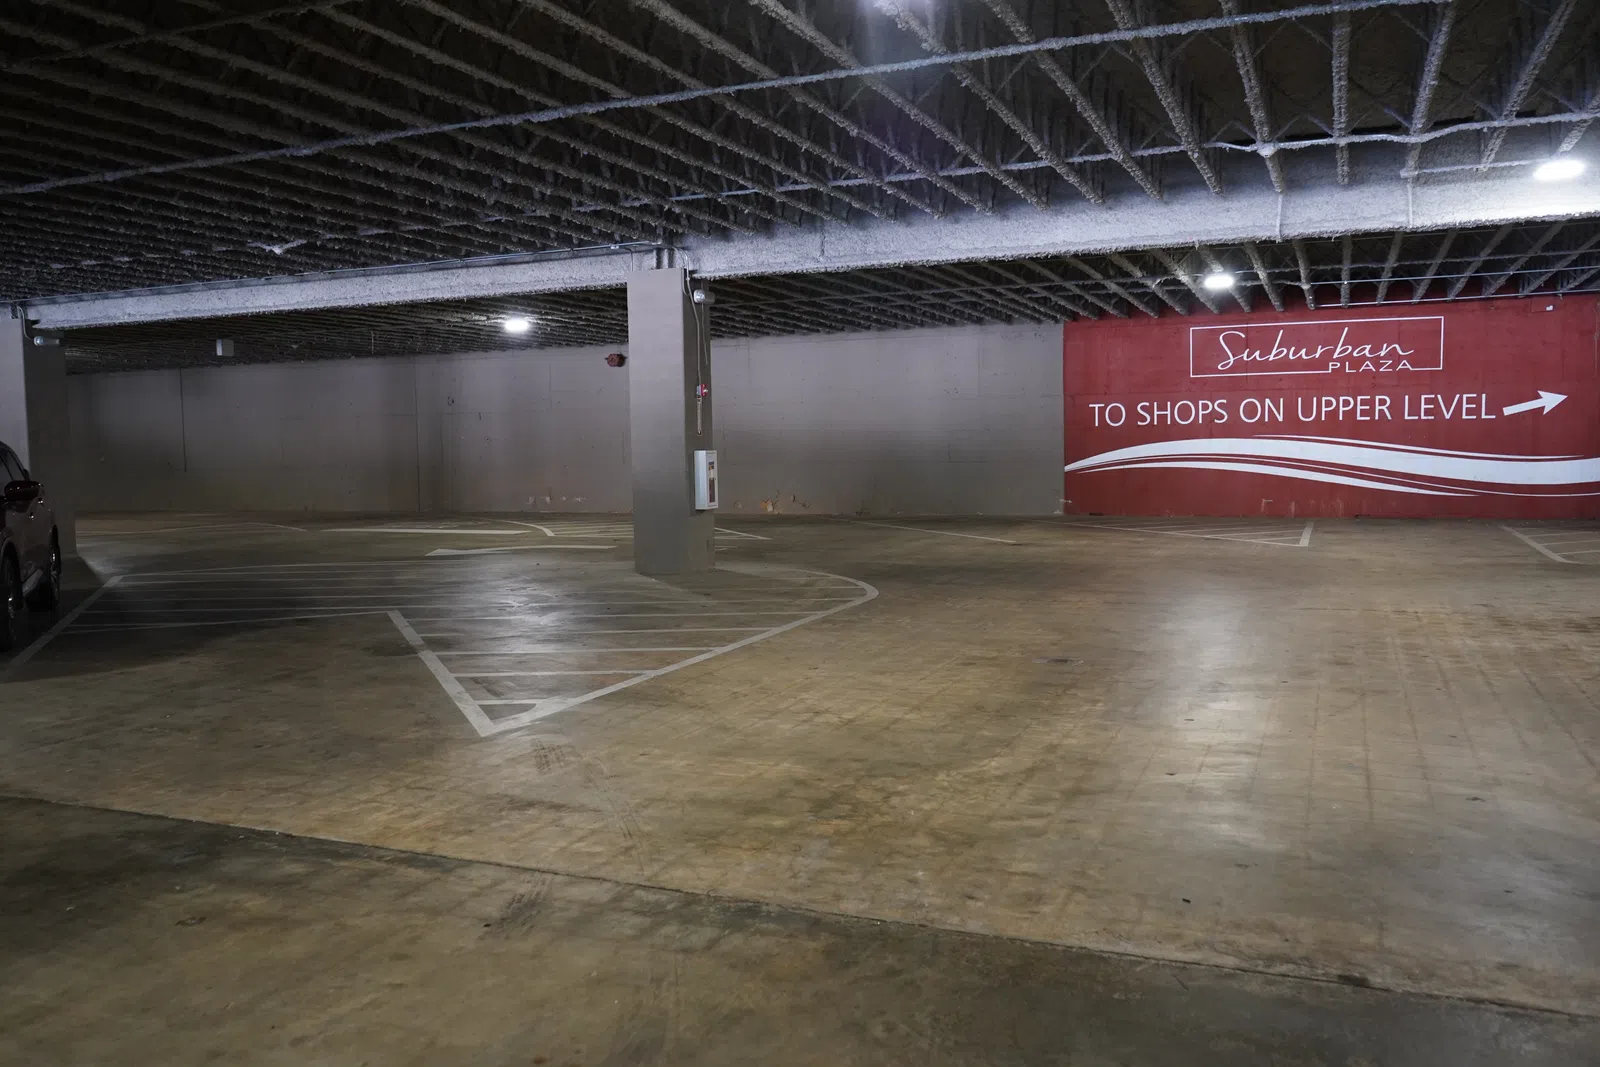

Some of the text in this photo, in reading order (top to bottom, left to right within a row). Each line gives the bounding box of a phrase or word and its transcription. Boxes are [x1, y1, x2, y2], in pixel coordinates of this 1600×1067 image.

[1217, 327, 1414, 370] Suburban
[1328, 360, 1413, 373] PLAZA
[1089, 393, 1496, 426] TO SHOPS ON UPPER LEVEL
